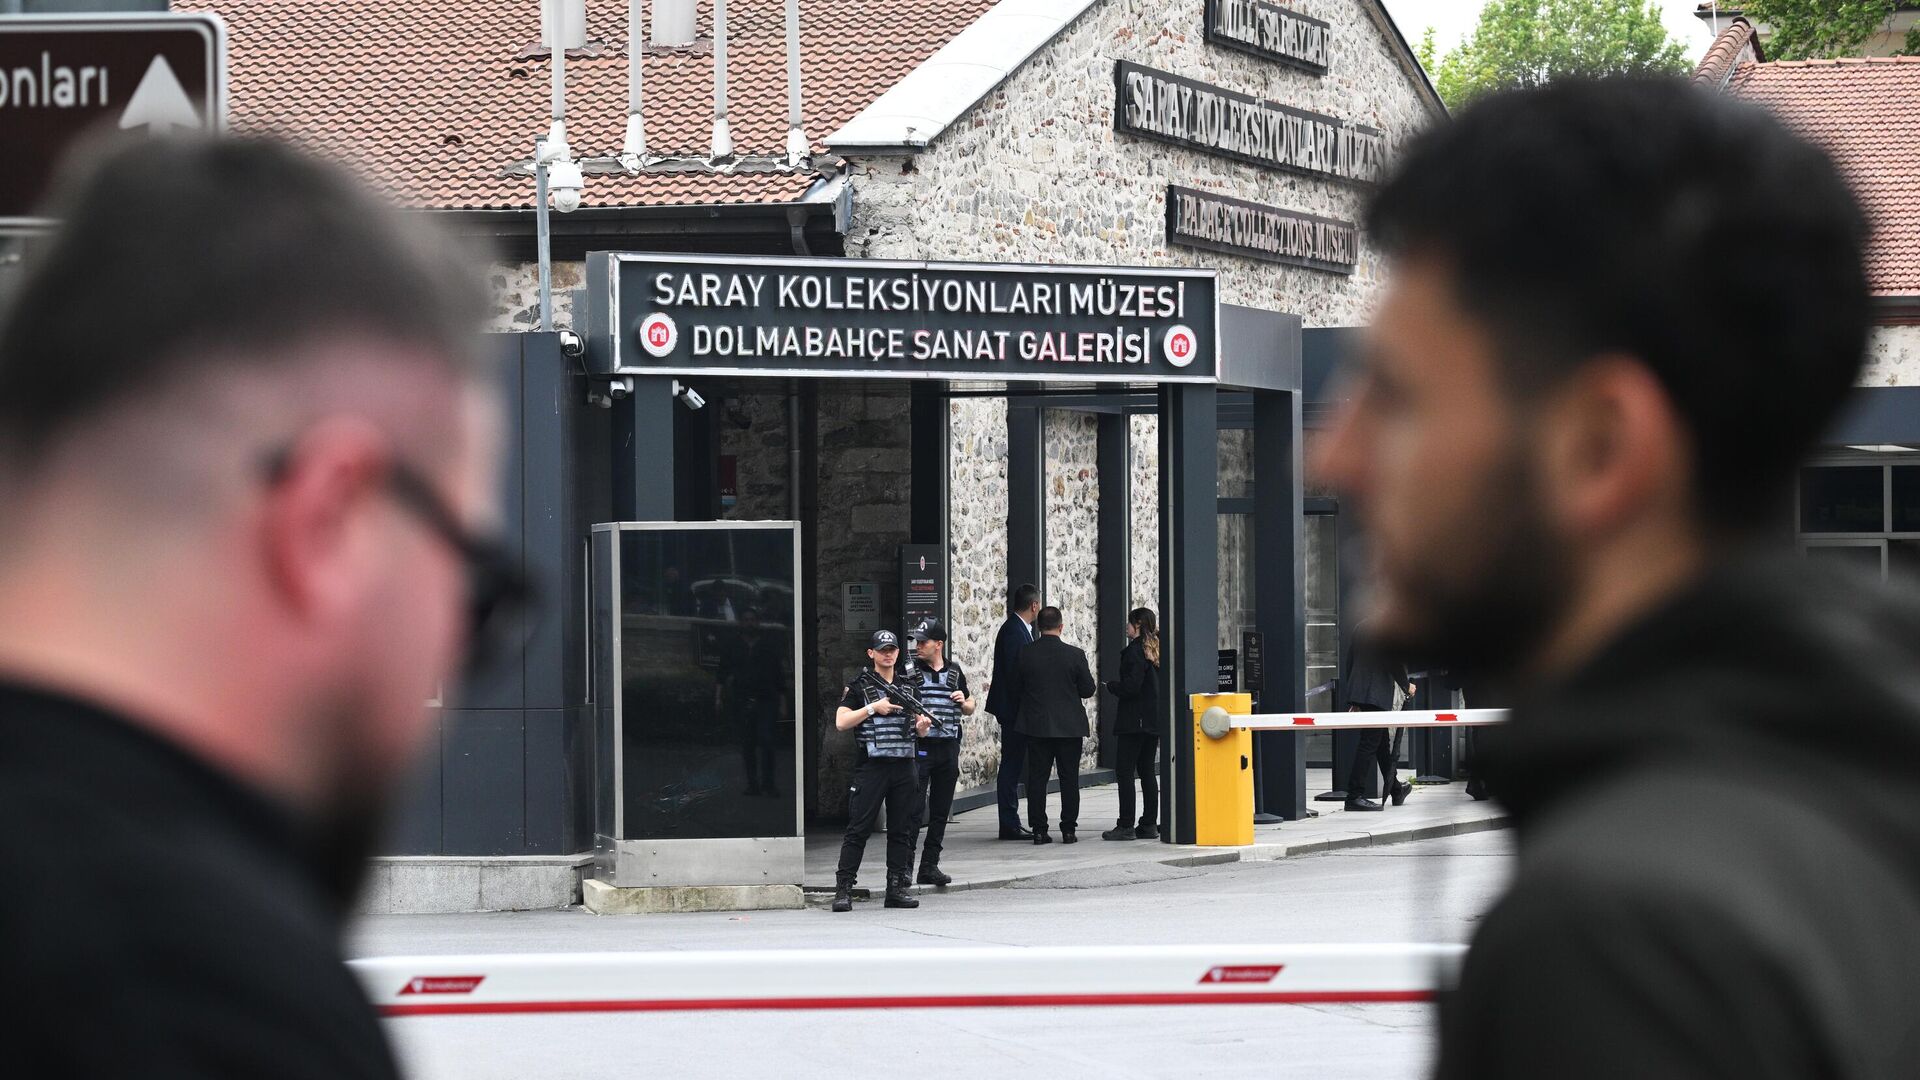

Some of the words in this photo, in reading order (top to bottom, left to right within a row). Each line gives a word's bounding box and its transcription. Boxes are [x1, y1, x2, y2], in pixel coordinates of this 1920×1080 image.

[1126, 72, 1192, 138] SARAY
[1232, 205, 1313, 259] COLLECTIONS
[1313, 221, 1360, 266] MUSEUM
[655, 272, 767, 307] SARAY
[778, 273, 1061, 315] KOLEKSİYONLARI
[1069, 278, 1185, 318] MÜZESİ
[692, 324, 905, 361] DOLMABAHÇE
[911, 329, 1011, 361] SANAT
[1018, 326, 1150, 364] GALERİSİ
